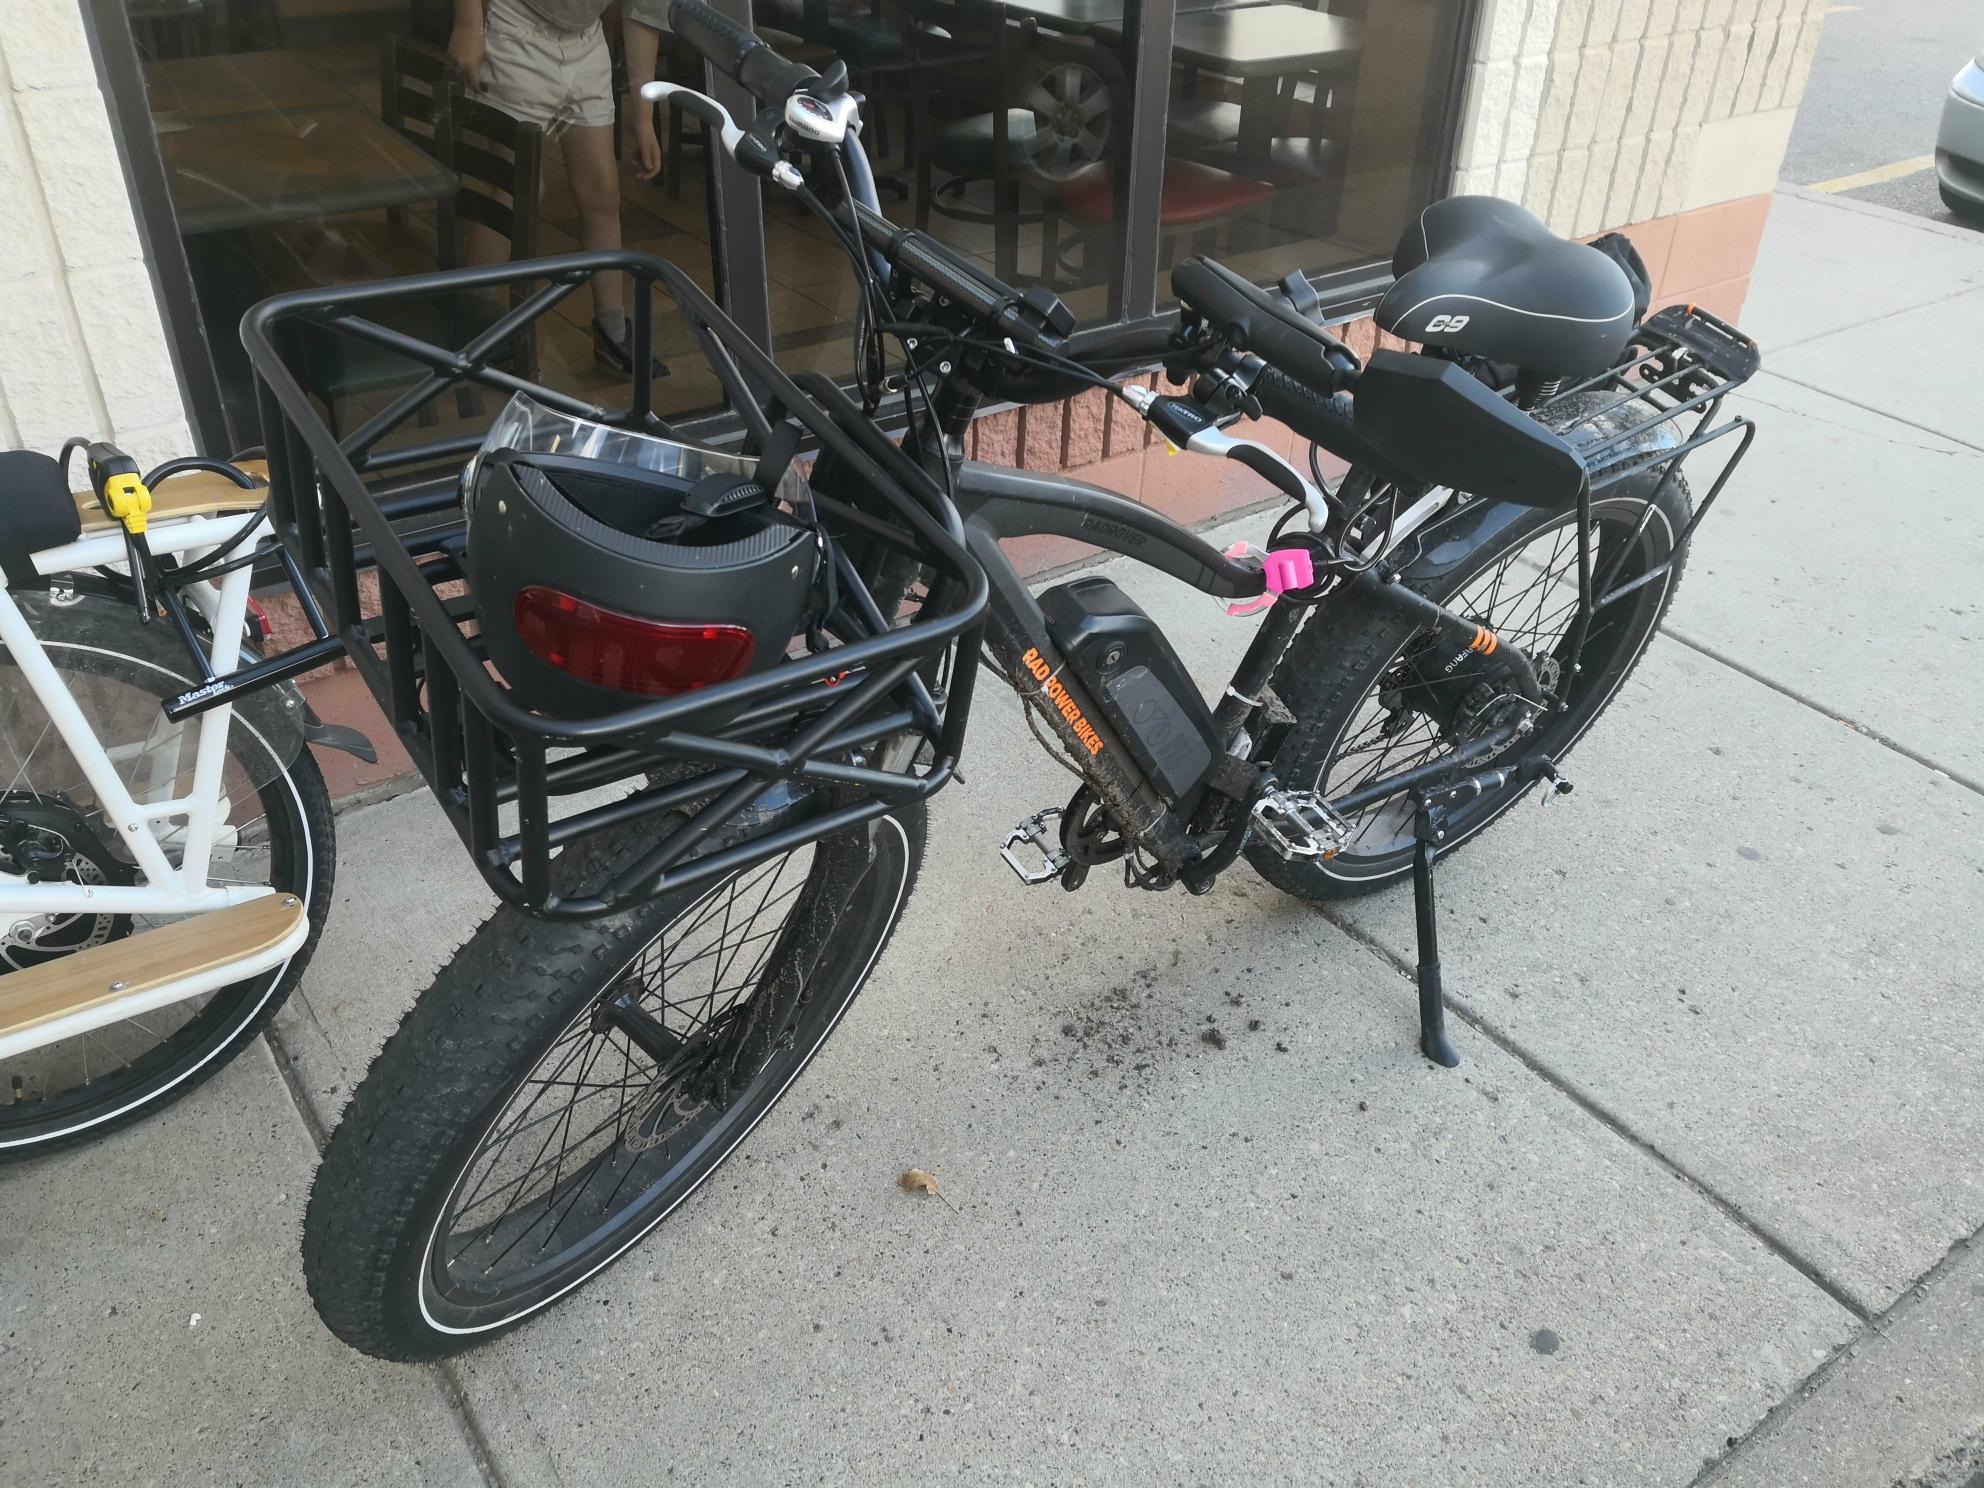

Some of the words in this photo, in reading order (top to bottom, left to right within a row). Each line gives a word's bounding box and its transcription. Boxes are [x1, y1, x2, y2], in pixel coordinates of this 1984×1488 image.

[1083, 517, 1147, 546] RADROVER
[1445, 646, 1475, 673] AFANG
[178, 681, 225, 705] Master
[1022, 647, 1050, 681] RAD
[1046, 674, 1081, 726] POWER
[1073, 717, 1105, 756] BIKES
